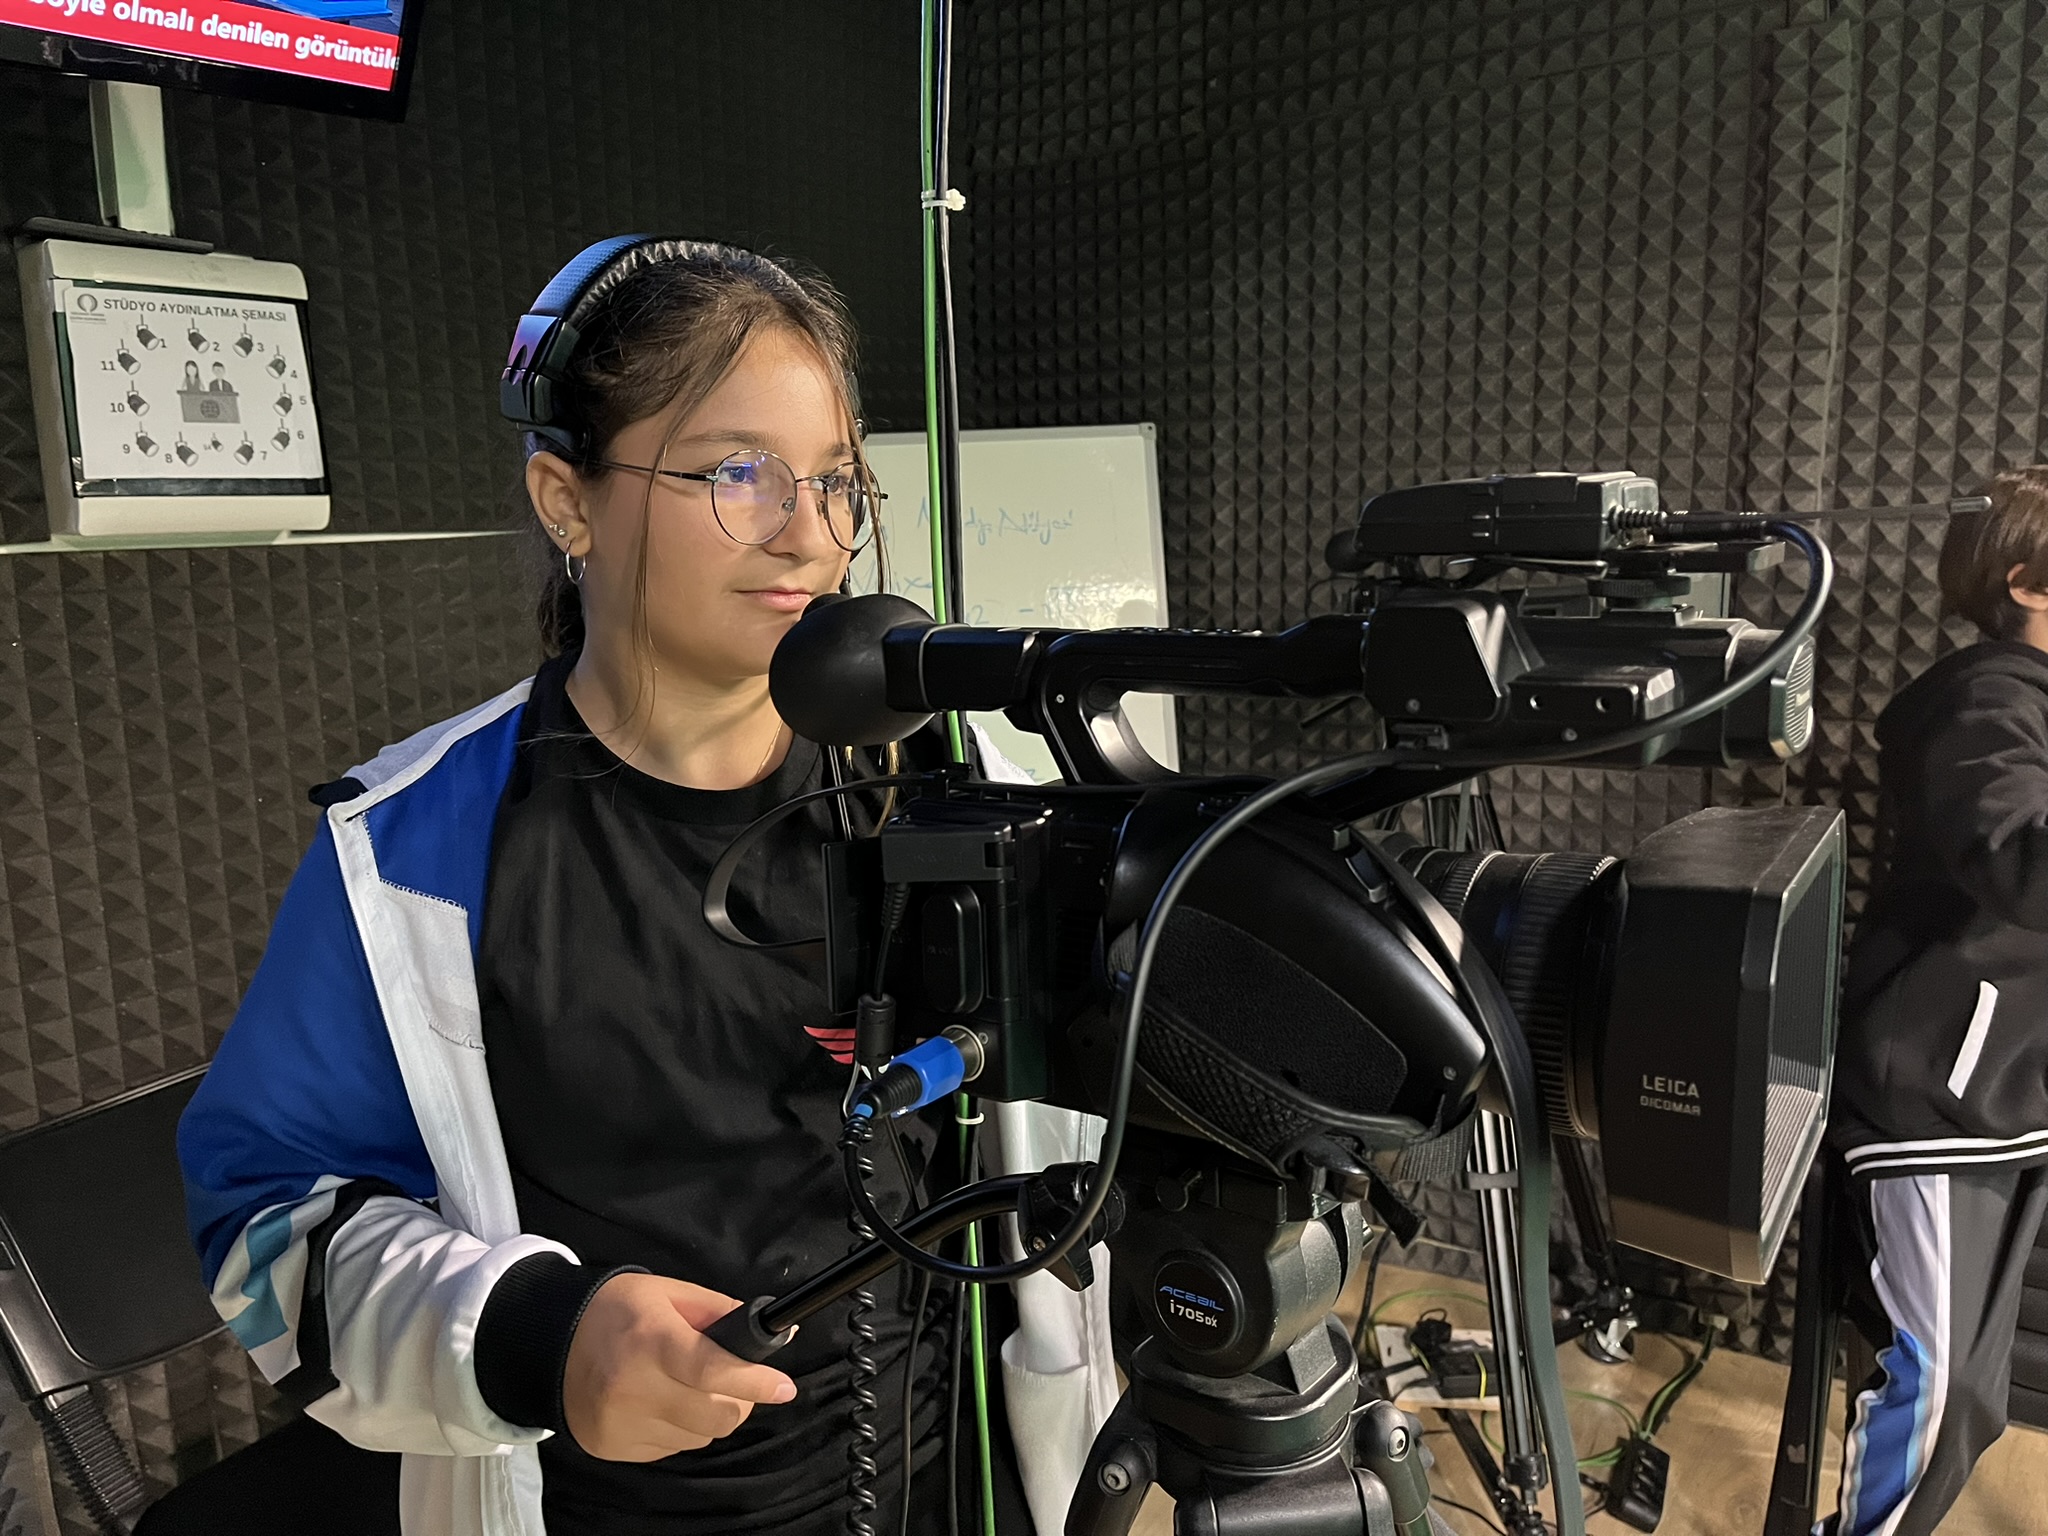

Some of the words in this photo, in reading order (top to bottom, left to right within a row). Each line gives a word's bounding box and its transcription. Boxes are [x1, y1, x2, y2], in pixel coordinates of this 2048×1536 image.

[113, 0, 194, 32] olmalı
[201, 14, 289, 49] denilen
[103, 298, 156, 312] STÜDYO
[160, 303, 239, 318] AYDINLATMA
[241, 309, 287, 321] ŞEMASI
[159, 339, 168, 349] 1
[212, 342, 221, 352] 2
[257, 342, 266, 352] 3
[101, 360, 117, 371] 11
[290, 370, 298, 379] 4
[299, 396, 307, 405] 5
[110, 403, 126, 413] 10
[297, 430, 305, 440] 6
[123, 445, 131, 454] 9
[165, 454, 174, 464] 8
[261, 451, 268, 460] 7
[1642, 1074, 1700, 1098] LEICA
[1640, 1095, 1701, 1117] DICOMAR
